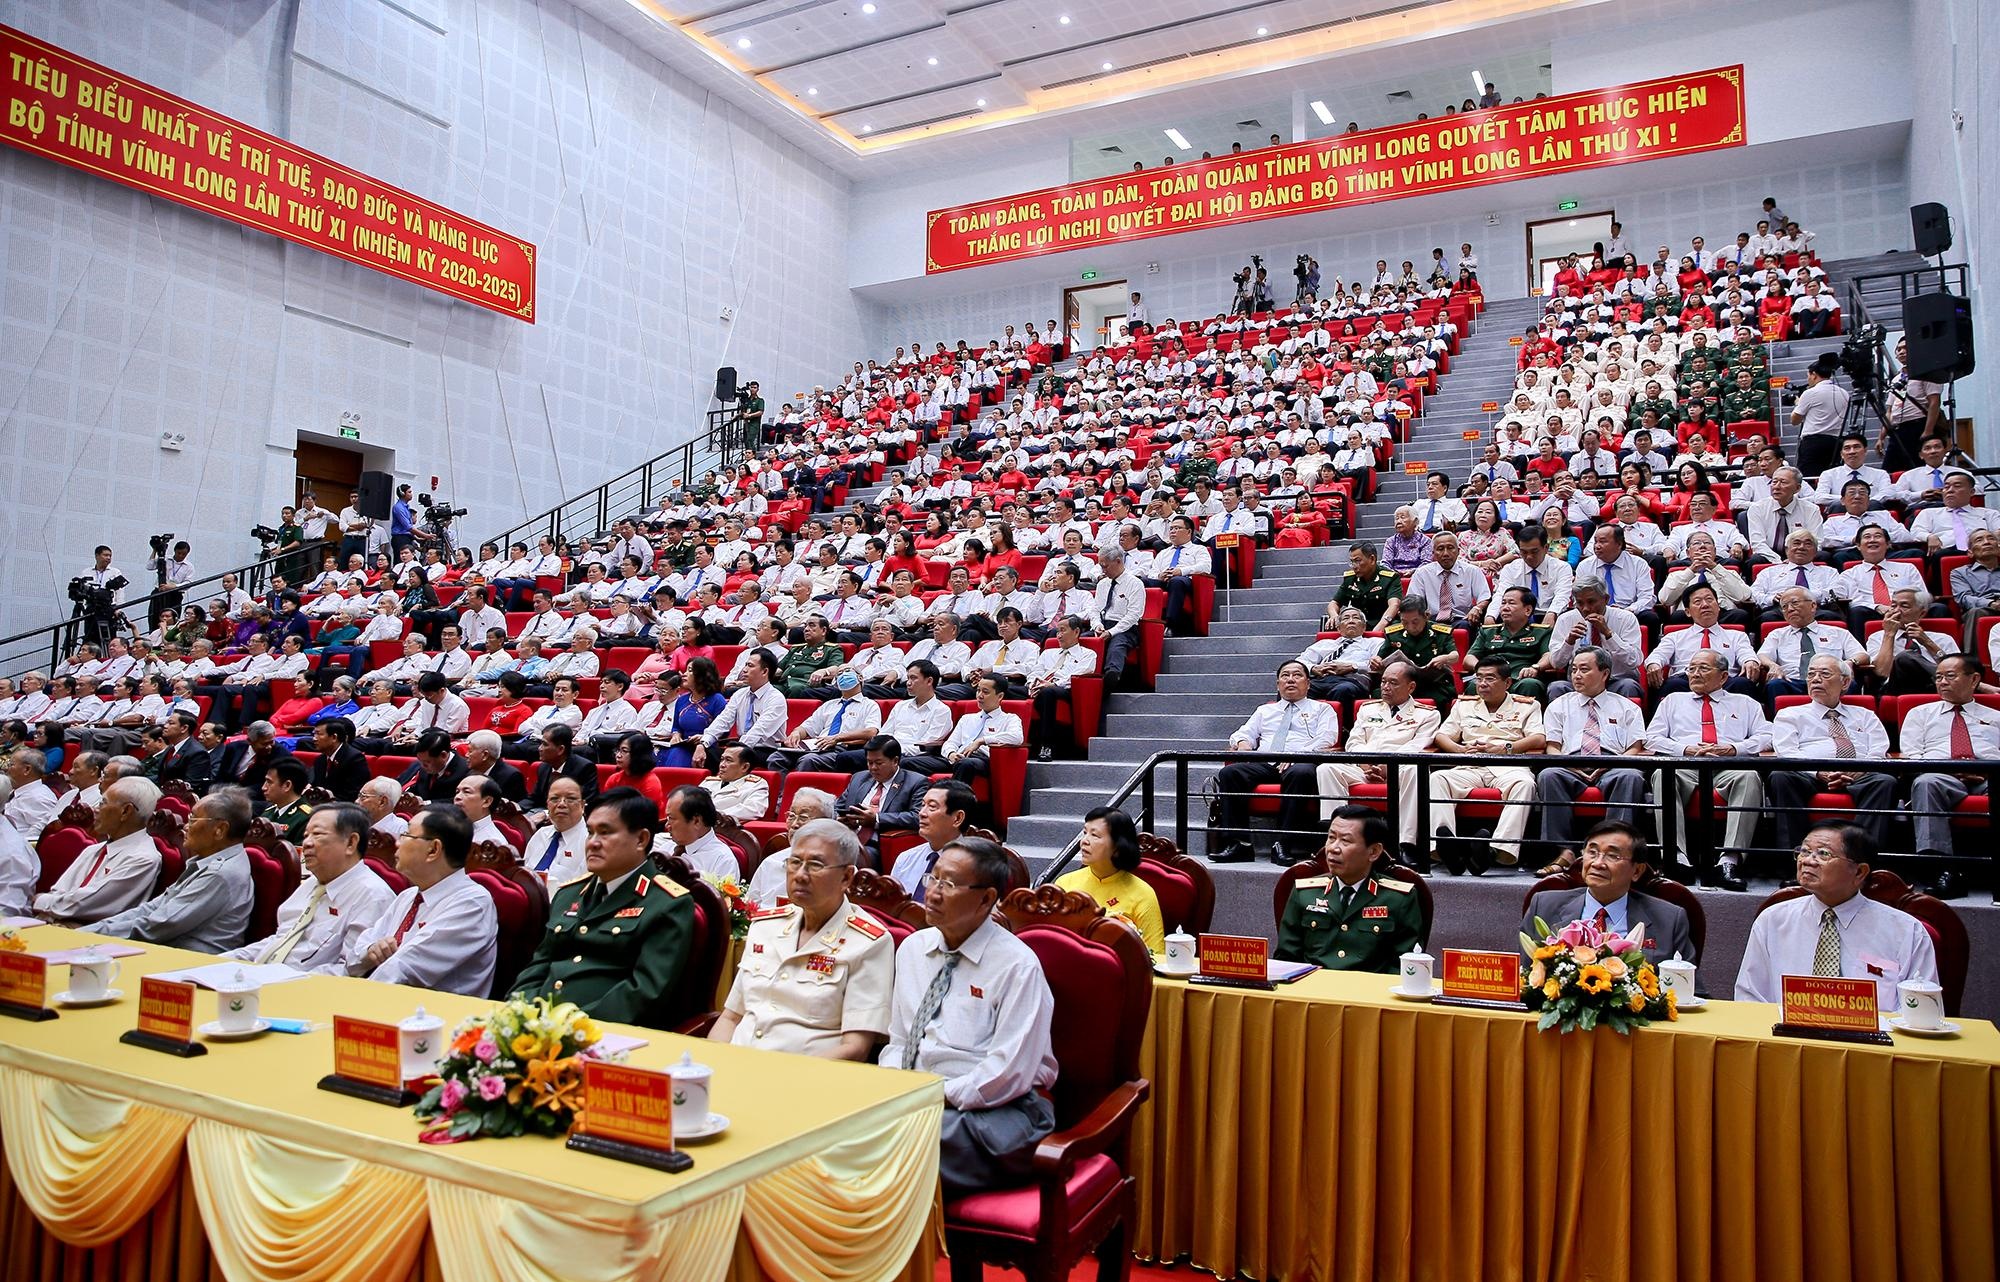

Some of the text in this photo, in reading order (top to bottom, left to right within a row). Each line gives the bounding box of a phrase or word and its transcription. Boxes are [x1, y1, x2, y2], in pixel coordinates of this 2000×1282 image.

[9, 97, 522, 308] BỘ TỈNH VĨNH LONG LẦN THỨ XI (NHIỆM KỲ 2020-2025)
[10, 52, 499, 265] TIÊU BIỂU NHẤT VỀ TRÍ TUỆ, ĐẠO ĐỨC VÀ NĂNG LỰC
[949, 85, 1707, 235] TOÀN ĐẢNG, TOÀN DÂN, TOÀN QUÂN TỈNH VĨNH LONG QUYẾT TÂM THỰC HIỆN
[967, 122, 1677, 257] THẮNG LỢI NGHỊ QUYẾT ĐẠI HỘI ĐẢNG BỘ TỈNH VĨNH LONG LẦN THỨ XI !
[1813, 993, 1846, 1009] SONG
